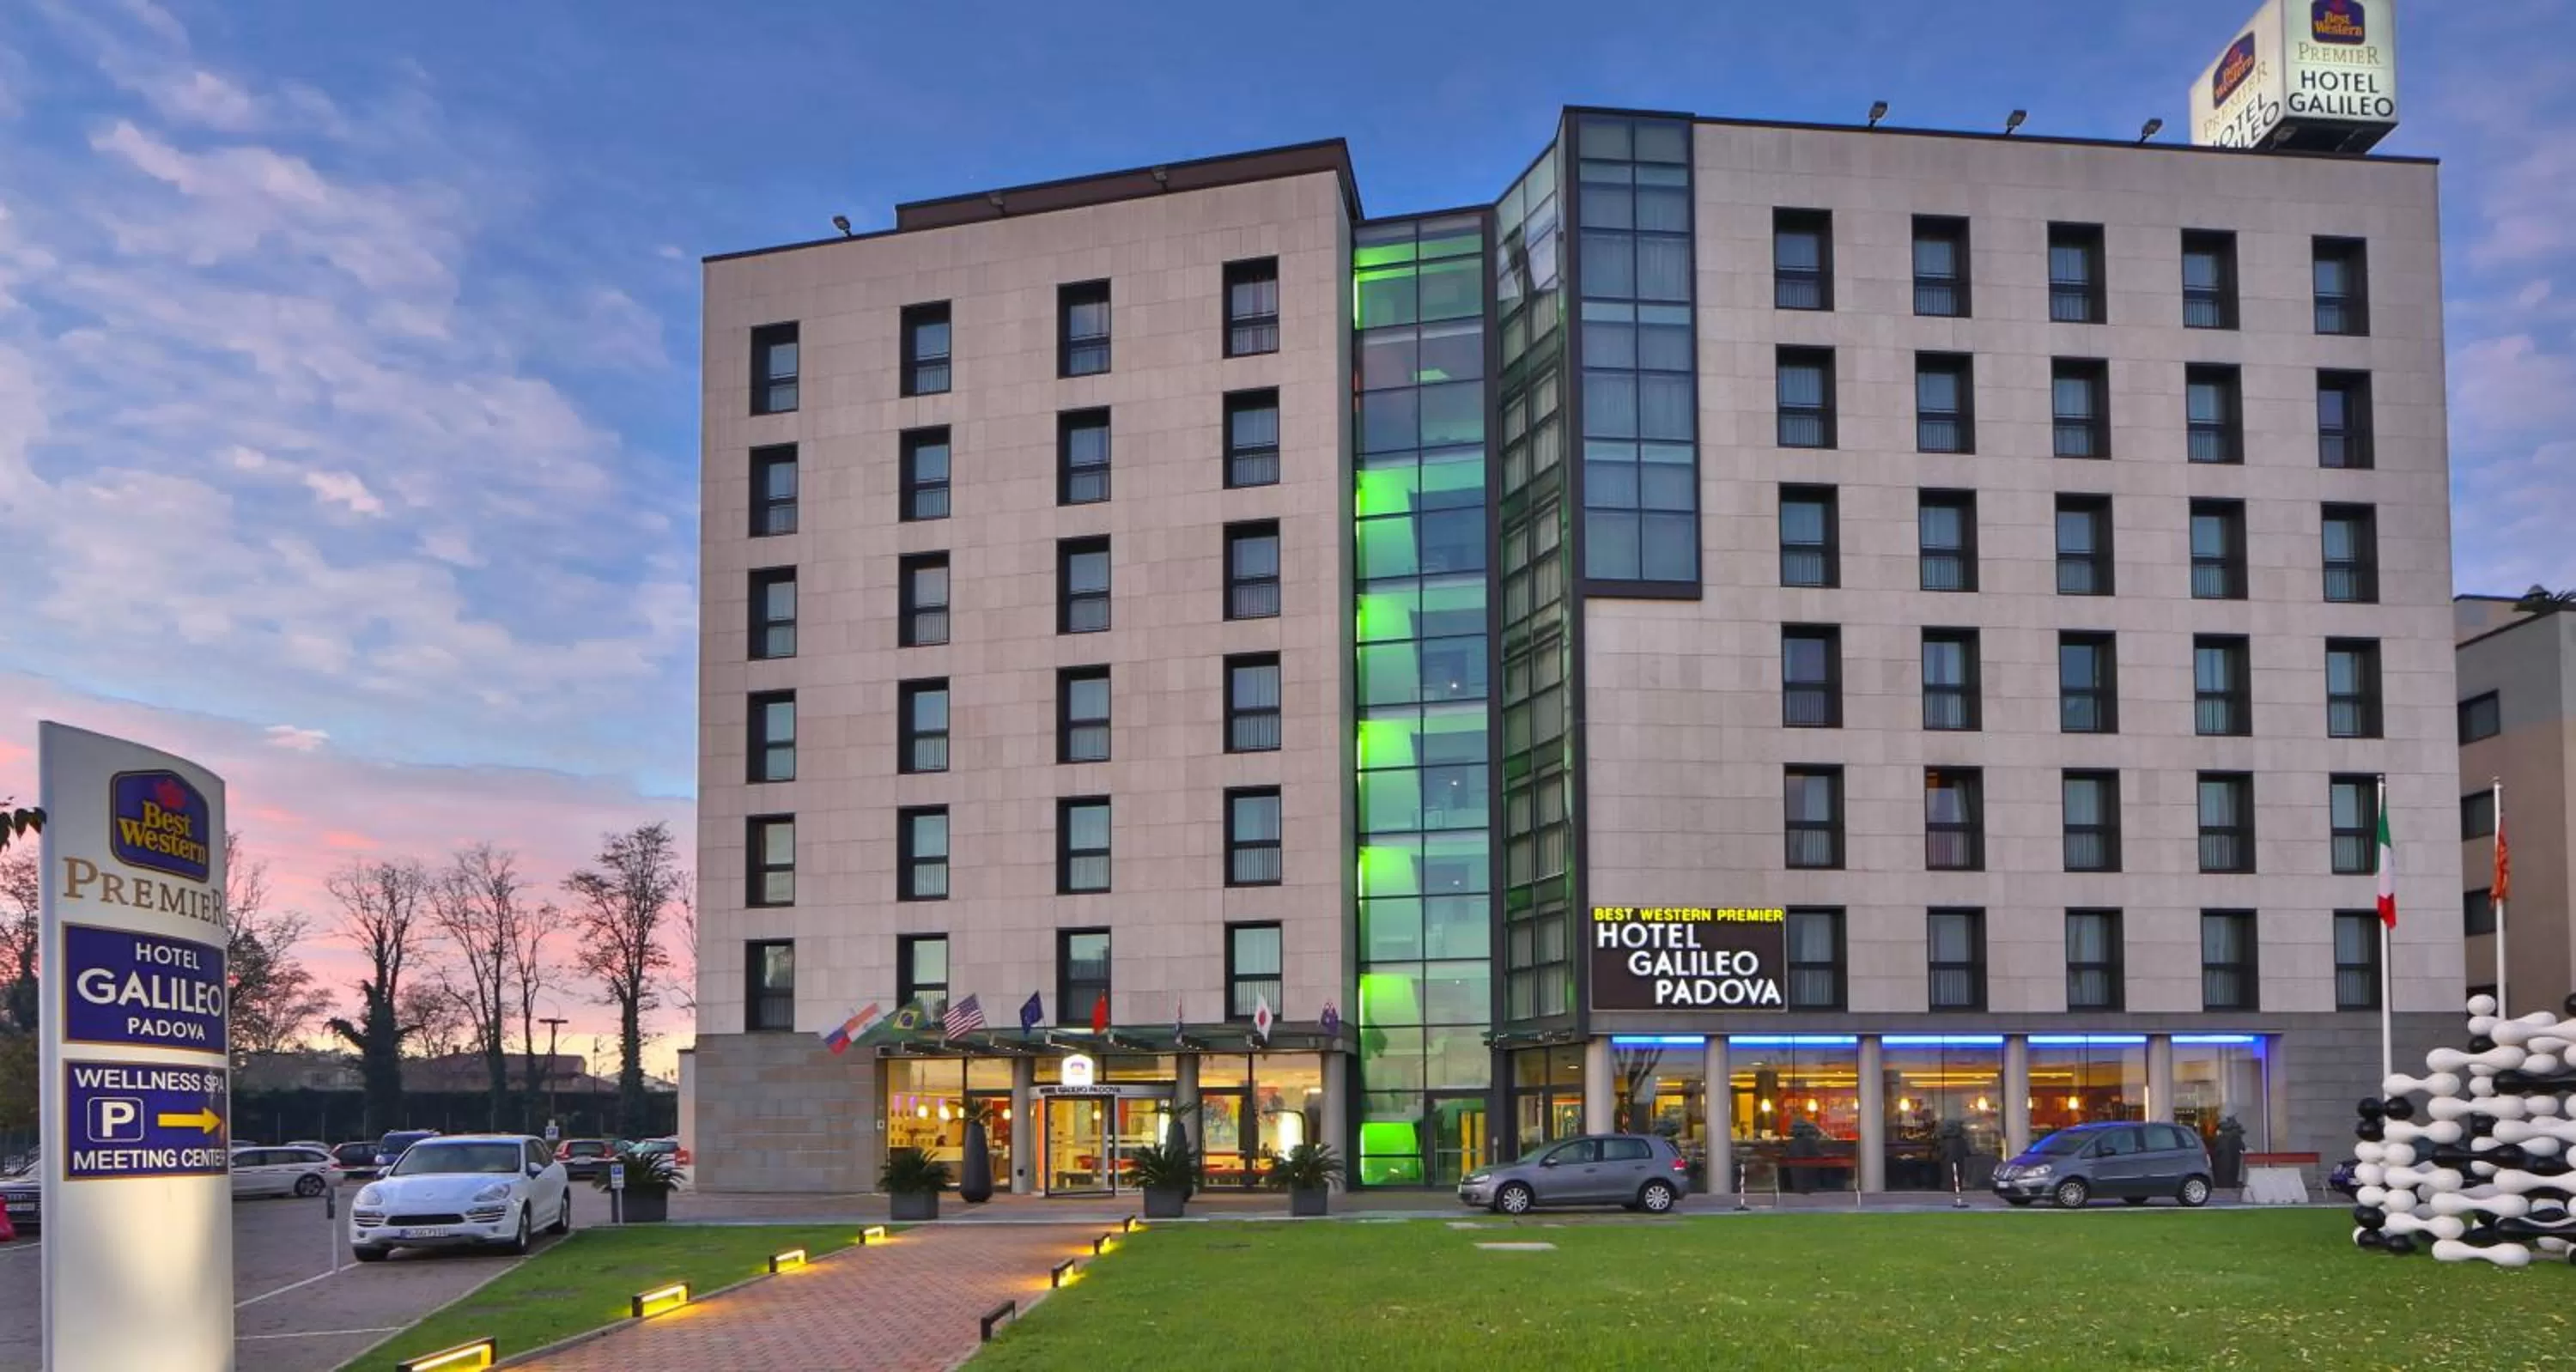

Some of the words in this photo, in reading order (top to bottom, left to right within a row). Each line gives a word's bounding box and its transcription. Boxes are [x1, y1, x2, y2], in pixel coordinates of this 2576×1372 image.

[2314, 20, 2363, 36] Western
[2324, 11, 2350, 25] Best
[2298, 41, 2380, 65] PREMIER
[2301, 70, 2379, 94] HOTEL
[2288, 92, 2393, 117] GALILEO
[2214, 92, 2266, 148] OTEL
[143, 799, 193, 838] Best
[117, 817, 207, 866] Western
[62, 856, 225, 928] PREMIER
[1594, 908, 1633, 921] BEST
[1639, 908, 1711, 921] WESTERN
[1717, 908, 1784, 922] PREMIER
[1596, 922, 1701, 948] HOTEL
[136, 942, 200, 969] HOTEL
[1628, 950, 1759, 976] GALILEO
[76, 968, 222, 1017] GALILEO
[1655, 978, 1782, 1005] PADOVA
[128, 1017, 205, 1041] PADOVA
[74, 1068, 200, 1091] WELLNESS
[204, 1074, 224, 1093] SPA
[102, 1102, 135, 1138] P
[73, 1149, 177, 1170] MEETING
